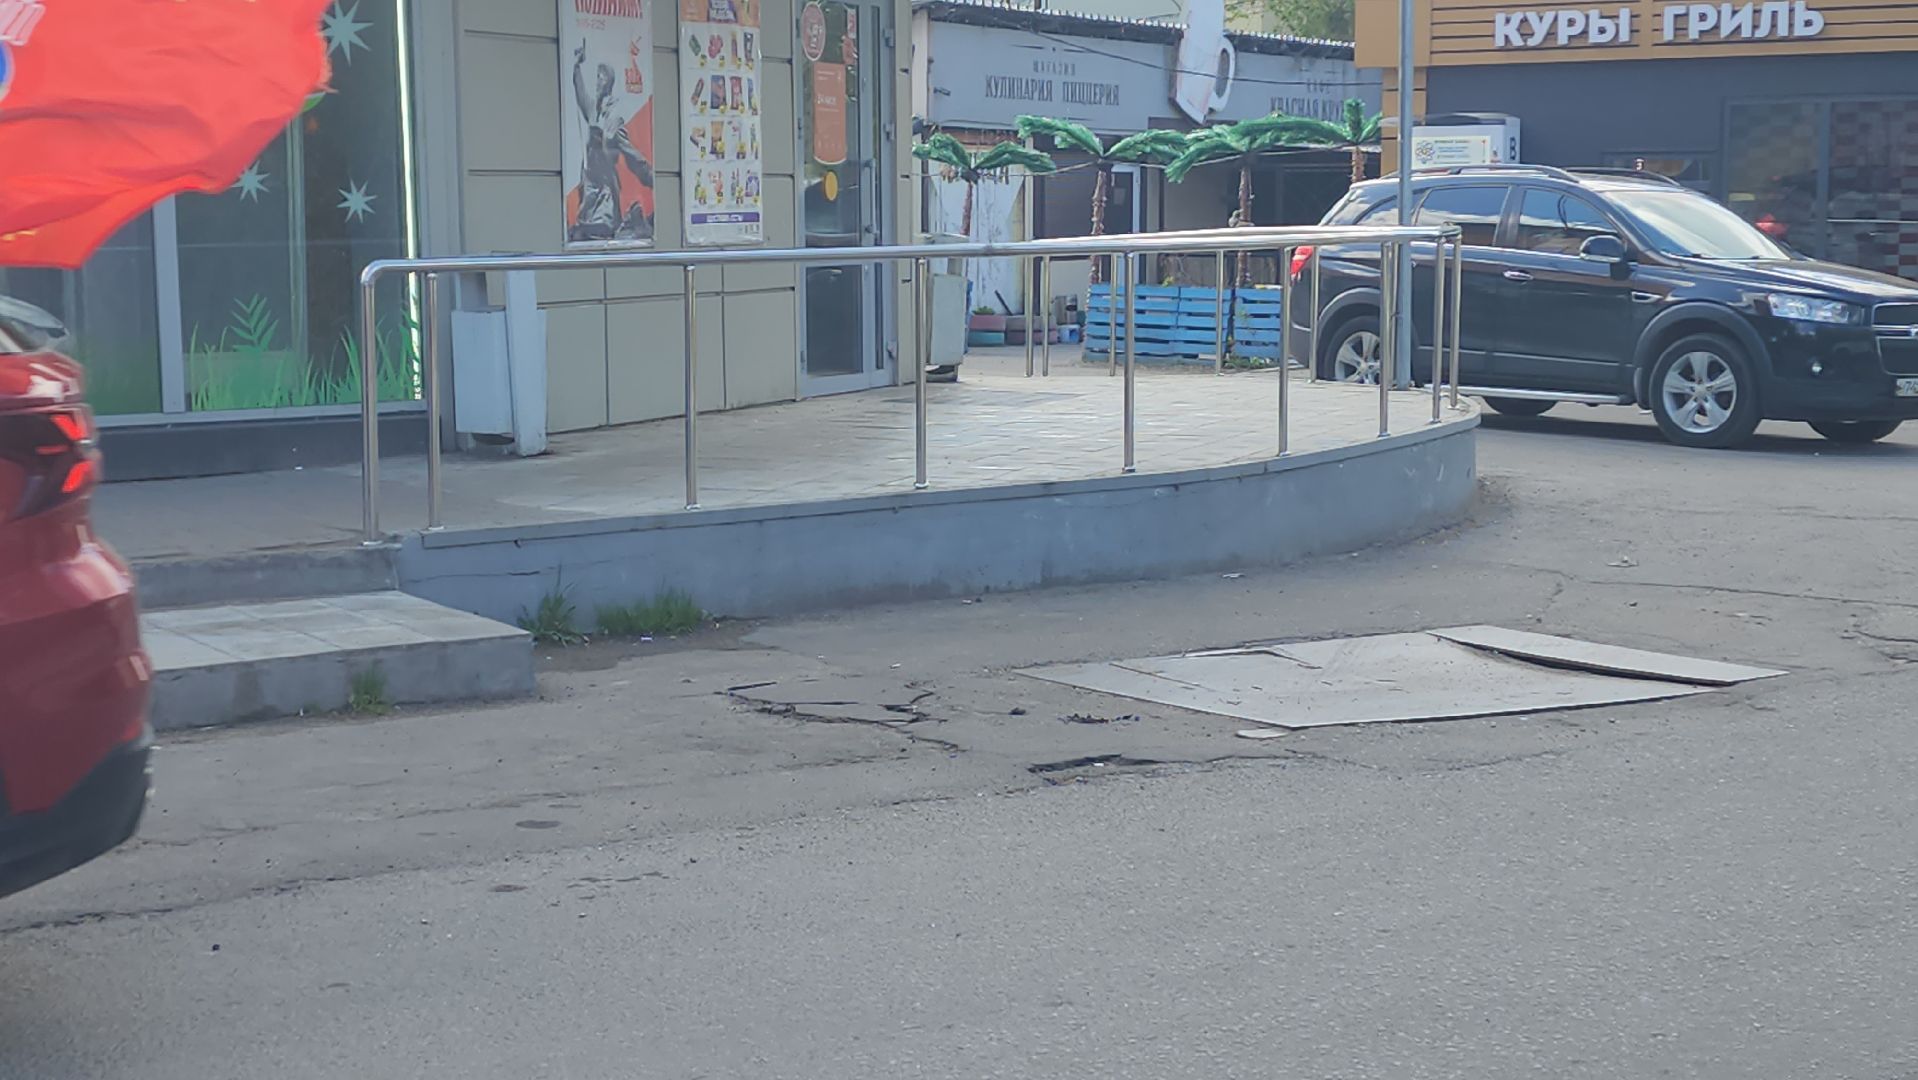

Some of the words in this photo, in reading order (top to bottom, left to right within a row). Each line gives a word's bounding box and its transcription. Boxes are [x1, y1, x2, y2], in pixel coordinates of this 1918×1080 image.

[1494, 7, 1633, 47] КУРЫ
[1662, 0, 1826, 41] ГРИЛЬ
[984, 74, 1054, 102] КУЛИНАРИЯ
[1062, 80, 1120, 106] ПИЦЦЕРИЯ
